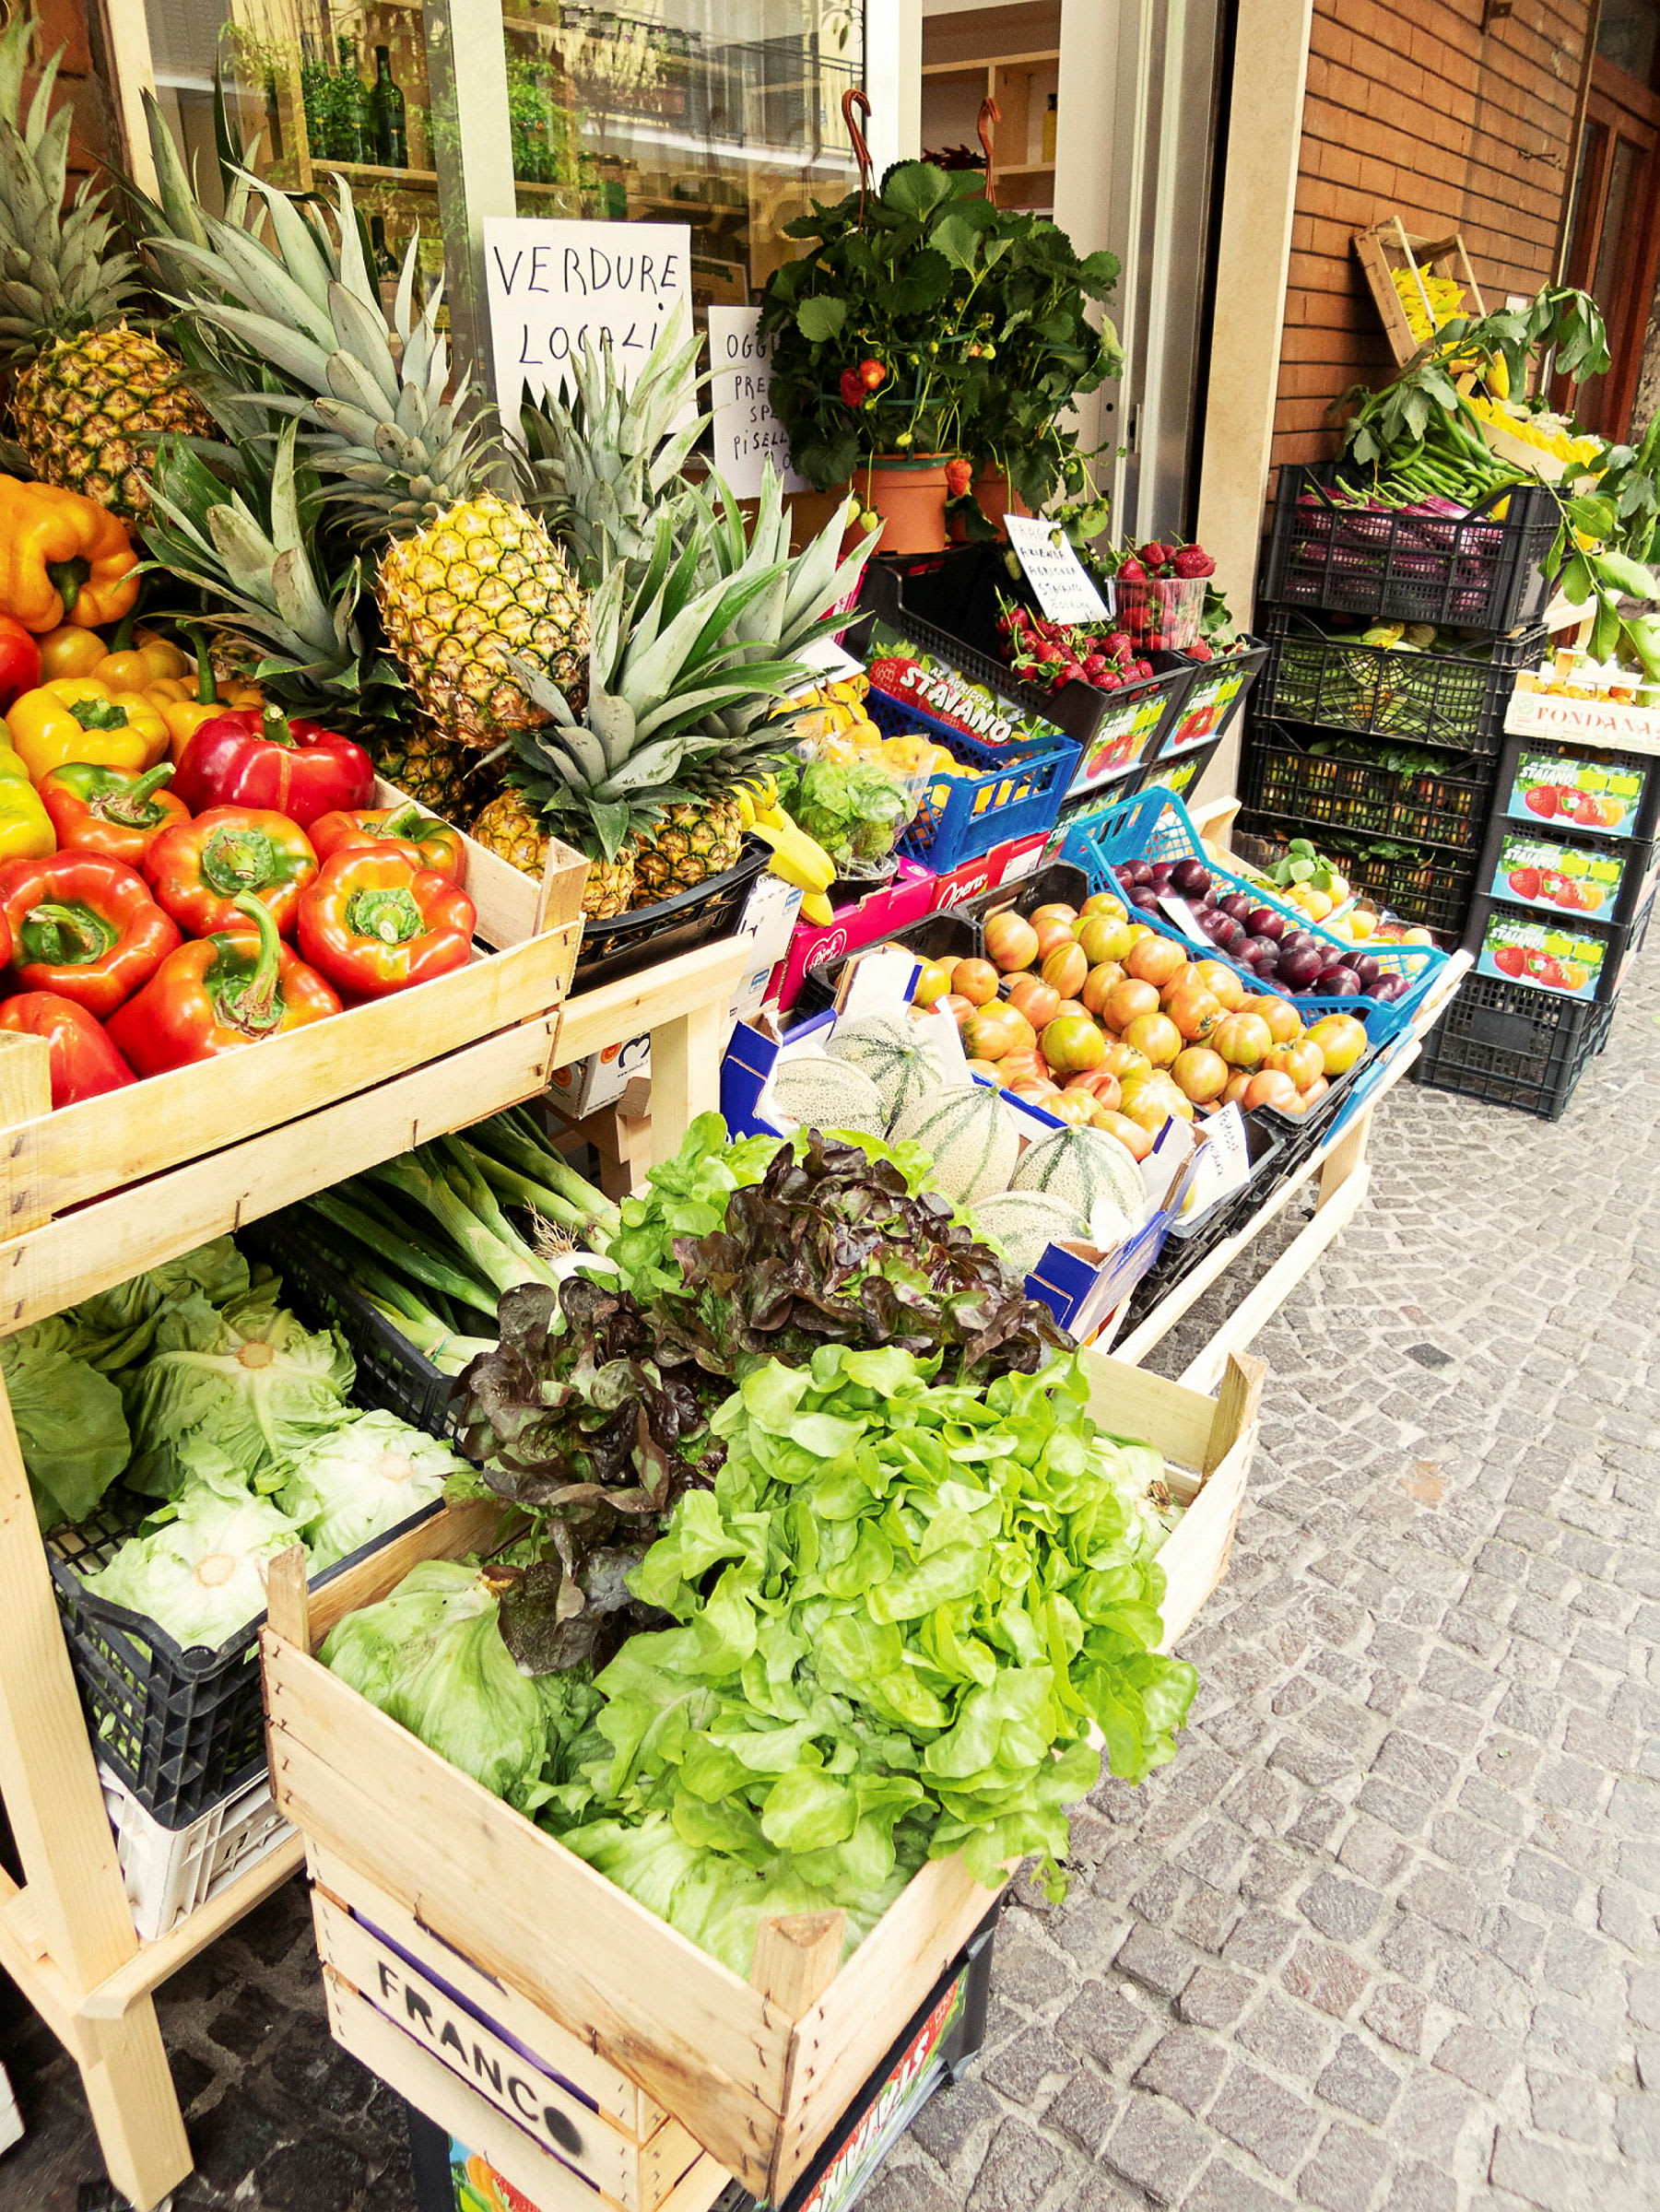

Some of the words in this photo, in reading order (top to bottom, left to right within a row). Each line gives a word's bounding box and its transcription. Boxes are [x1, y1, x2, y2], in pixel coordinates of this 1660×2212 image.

[493, 246, 678, 295] VERDURE
[519, 303, 664, 364] LOCALI
[900, 666, 1012, 743] STAIANO
[947, 677, 995, 709] AGRICOLA
[377, 1960, 583, 2158] FRANCO
